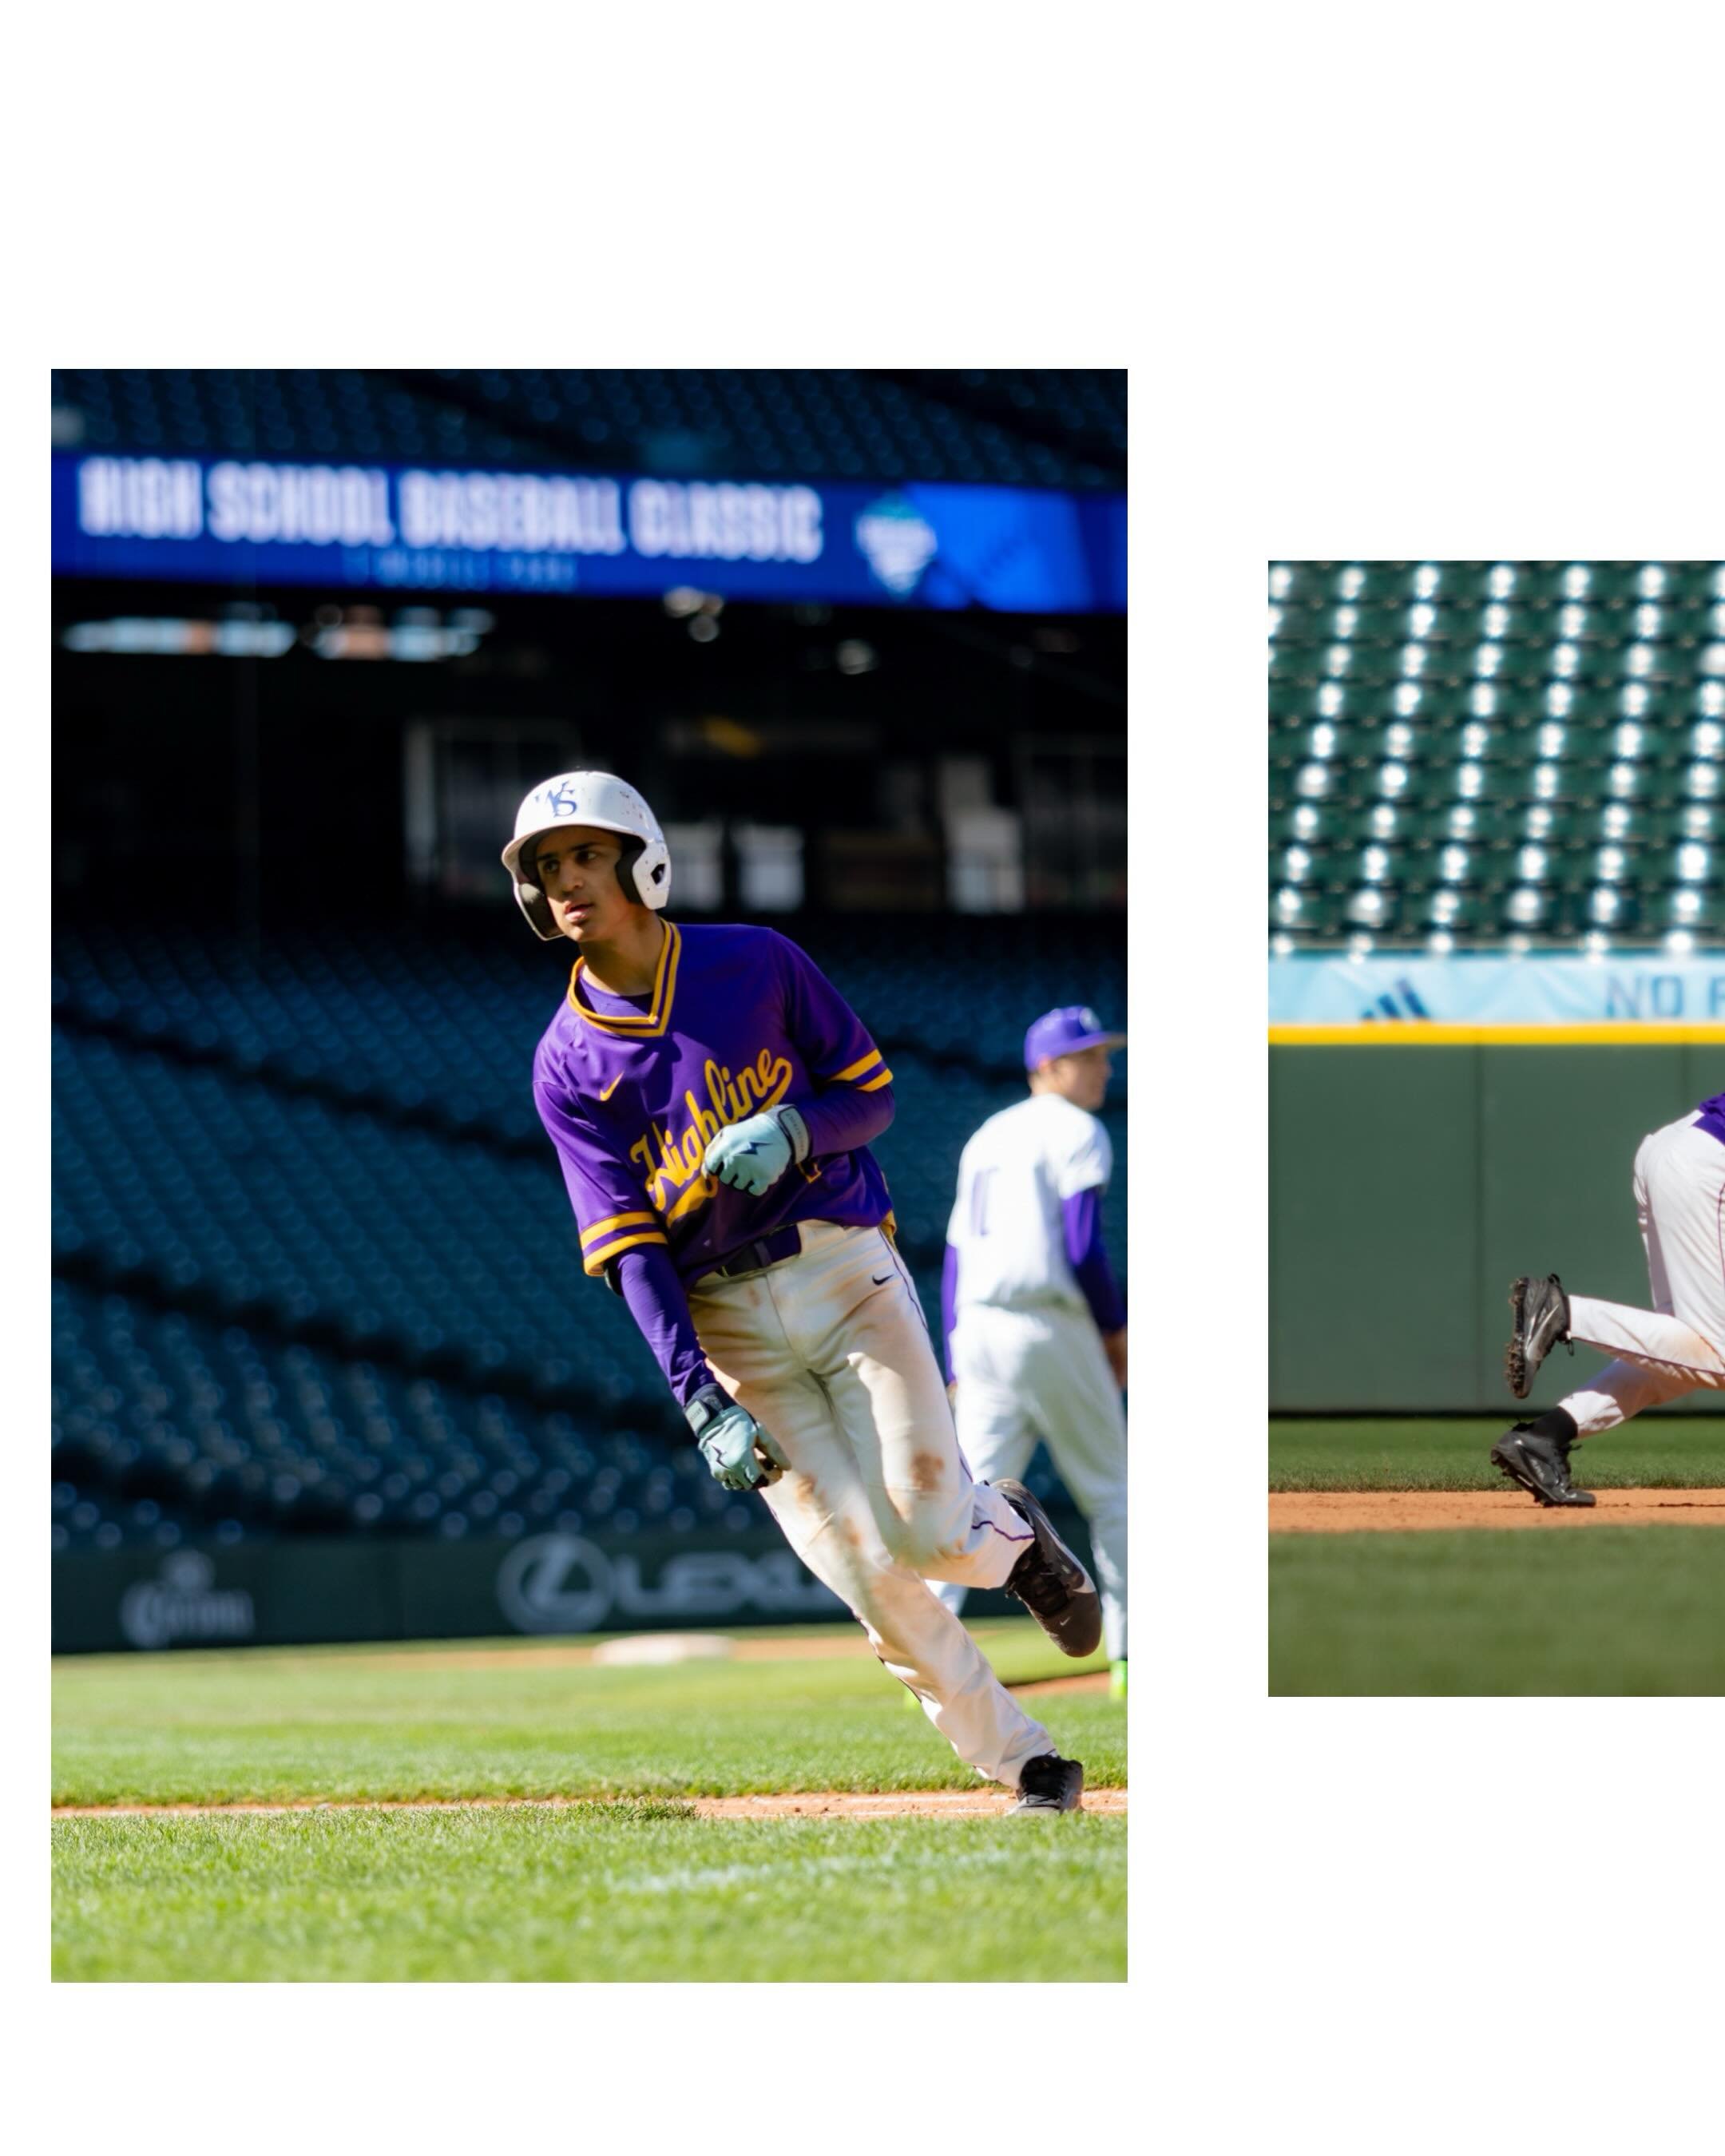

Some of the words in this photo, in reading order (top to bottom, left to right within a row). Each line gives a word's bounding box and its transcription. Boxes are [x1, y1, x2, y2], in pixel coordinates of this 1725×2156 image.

[79, 458, 203, 538] HIGH
[208, 462, 395, 546] SCHOOL
[401, 470, 626, 554] BASEBALL
[629, 478, 823, 564] CLASSIC
[1606, 975, 1684, 1019] NO
[629, 1048, 793, 1211] Highline
